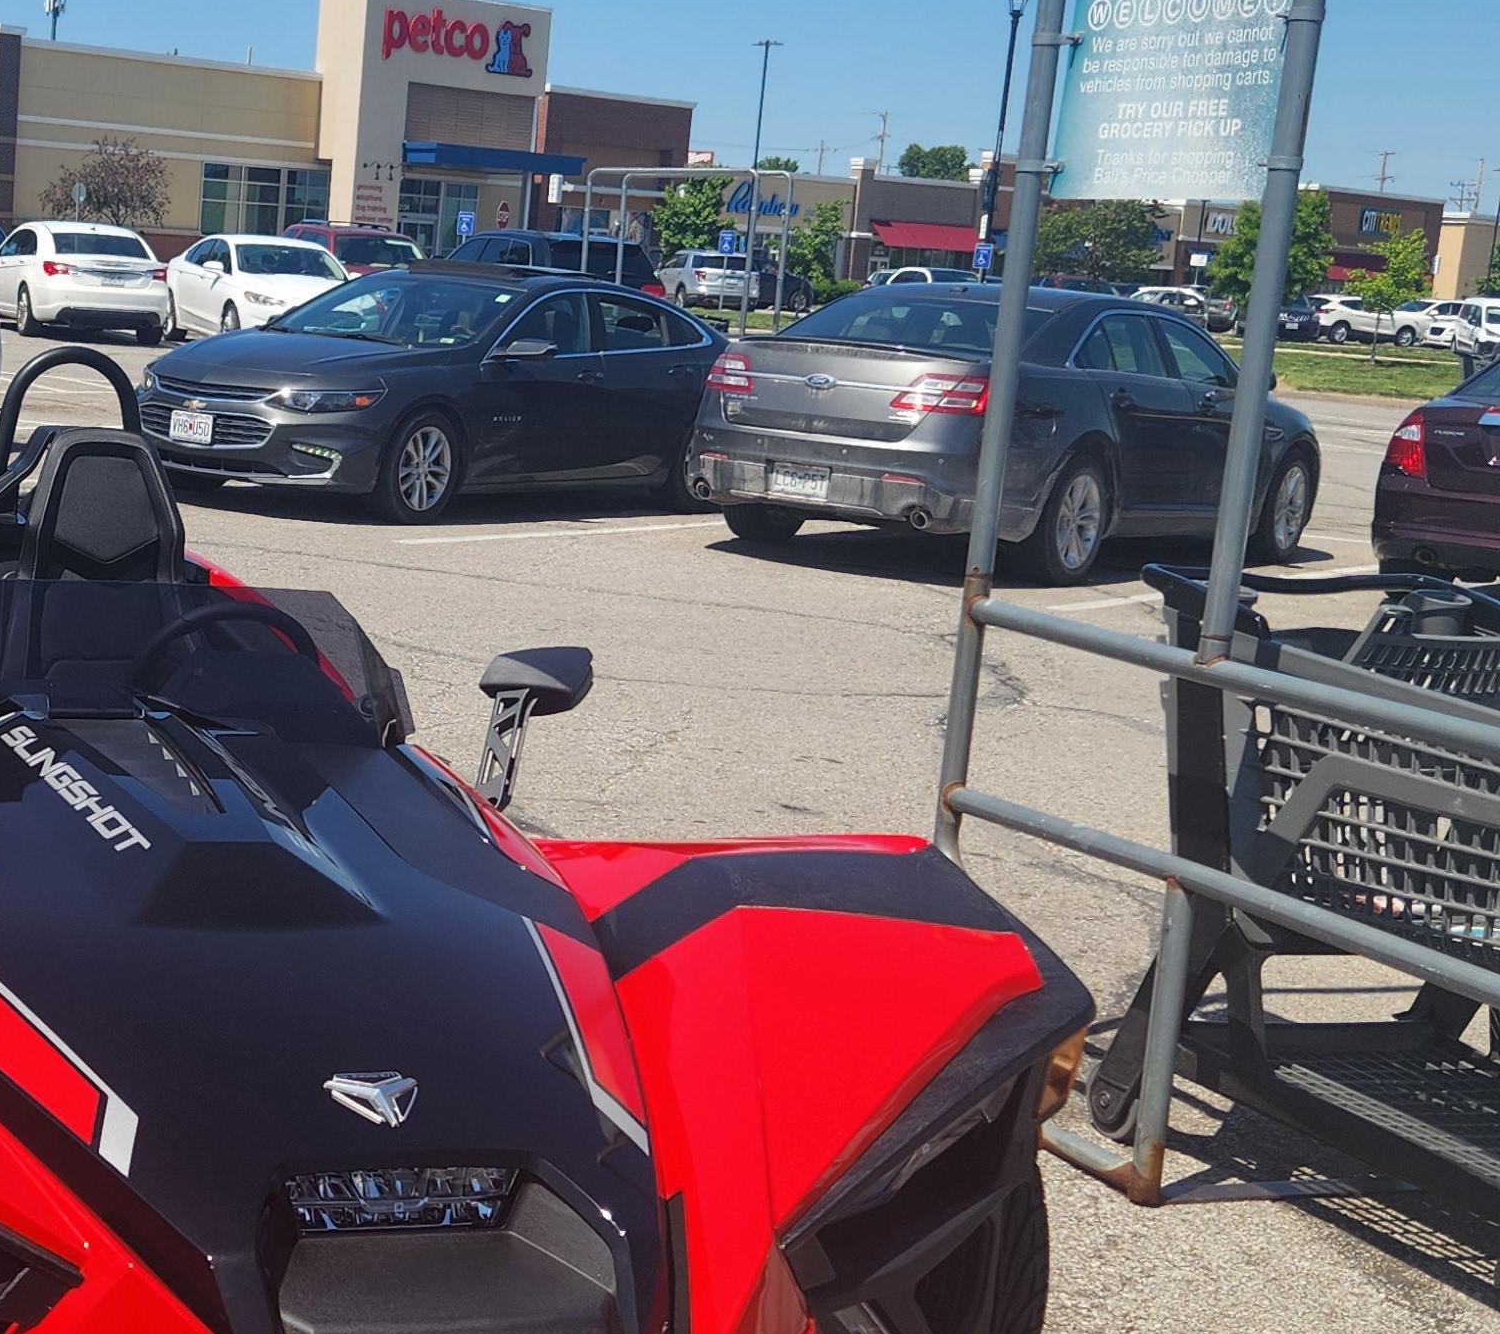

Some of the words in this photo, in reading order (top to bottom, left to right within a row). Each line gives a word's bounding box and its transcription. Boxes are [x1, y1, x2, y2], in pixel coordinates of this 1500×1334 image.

[381, 7, 490, 61] petco
[1092, 36, 1113, 54] We
[1116, 37, 1137, 52] are
[1141, 34, 1175, 52] sorry
[1178, 29, 1200, 48] but
[1205, 31, 1223, 45] we
[1227, 25, 1275, 44] cannot
[1082, 57, 1100, 74] be
[1103, 52, 1179, 74] responsible
[1182, 50, 1202, 68] for
[1205, 47, 1260, 69] damage
[1263, 47, 1277, 63] to
[1080, 75, 1132, 94] vehicles
[1135, 74, 1166, 91] from
[1170, 72, 1232, 92] shopping
[1236, 69, 1274, 86] carts.
[1117, 102, 1146, 120] TRY
[1150, 101, 1184, 118] OUR
[1189, 99, 1230, 117] FREE
[1098, 121, 1172, 140] GROCERY
[1177, 120, 1215, 138] PICK
[1219, 118, 1243, 137] UP
[1097, 148, 1145, 166] Thanks
[1148, 148, 1168, 165] for
[1171, 147, 1235, 168] shopping
[1132, 167, 1168, 185] Price
[1171, 166, 1233, 185] Chopper
[0, 725, 152, 852] SLINGSHOT
